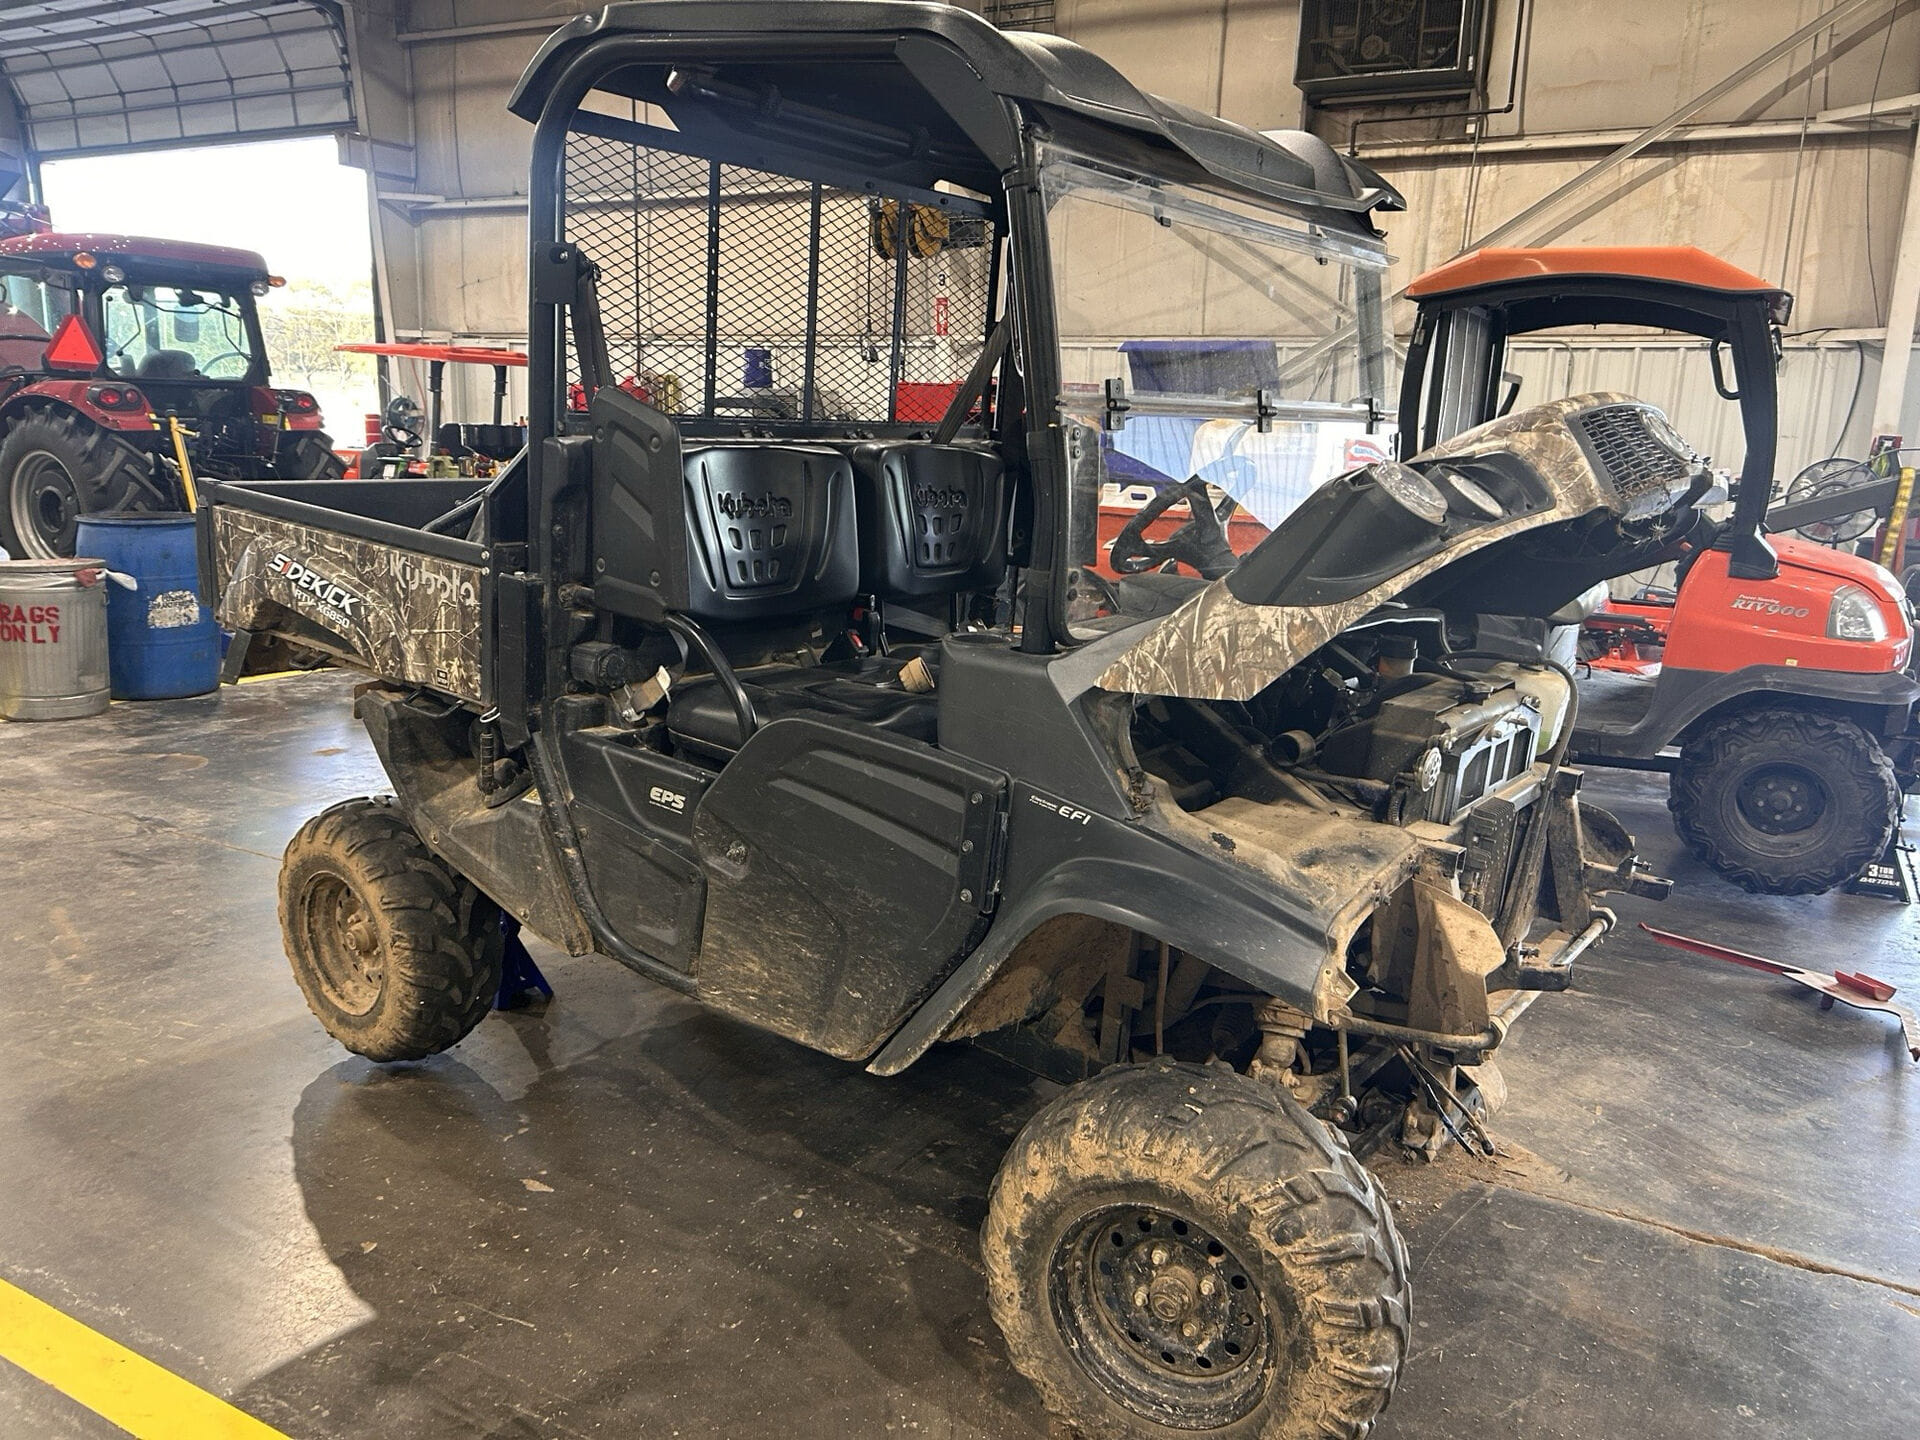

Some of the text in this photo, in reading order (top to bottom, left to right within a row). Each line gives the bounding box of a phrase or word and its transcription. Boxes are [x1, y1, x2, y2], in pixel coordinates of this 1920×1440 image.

[717, 490, 793, 520] Kubota
[268, 552, 361, 616] SIDEKICK
[389, 550, 476, 606] Kubota
[0, 604, 60, 624] RAGS
[1730, 598, 1810, 618] RTV900
[0, 624, 60, 643] ONLY
[650, 786, 686, 809] EPS
[1058, 805, 1092, 825] EFI
[1868, 864, 1879, 877] 3
